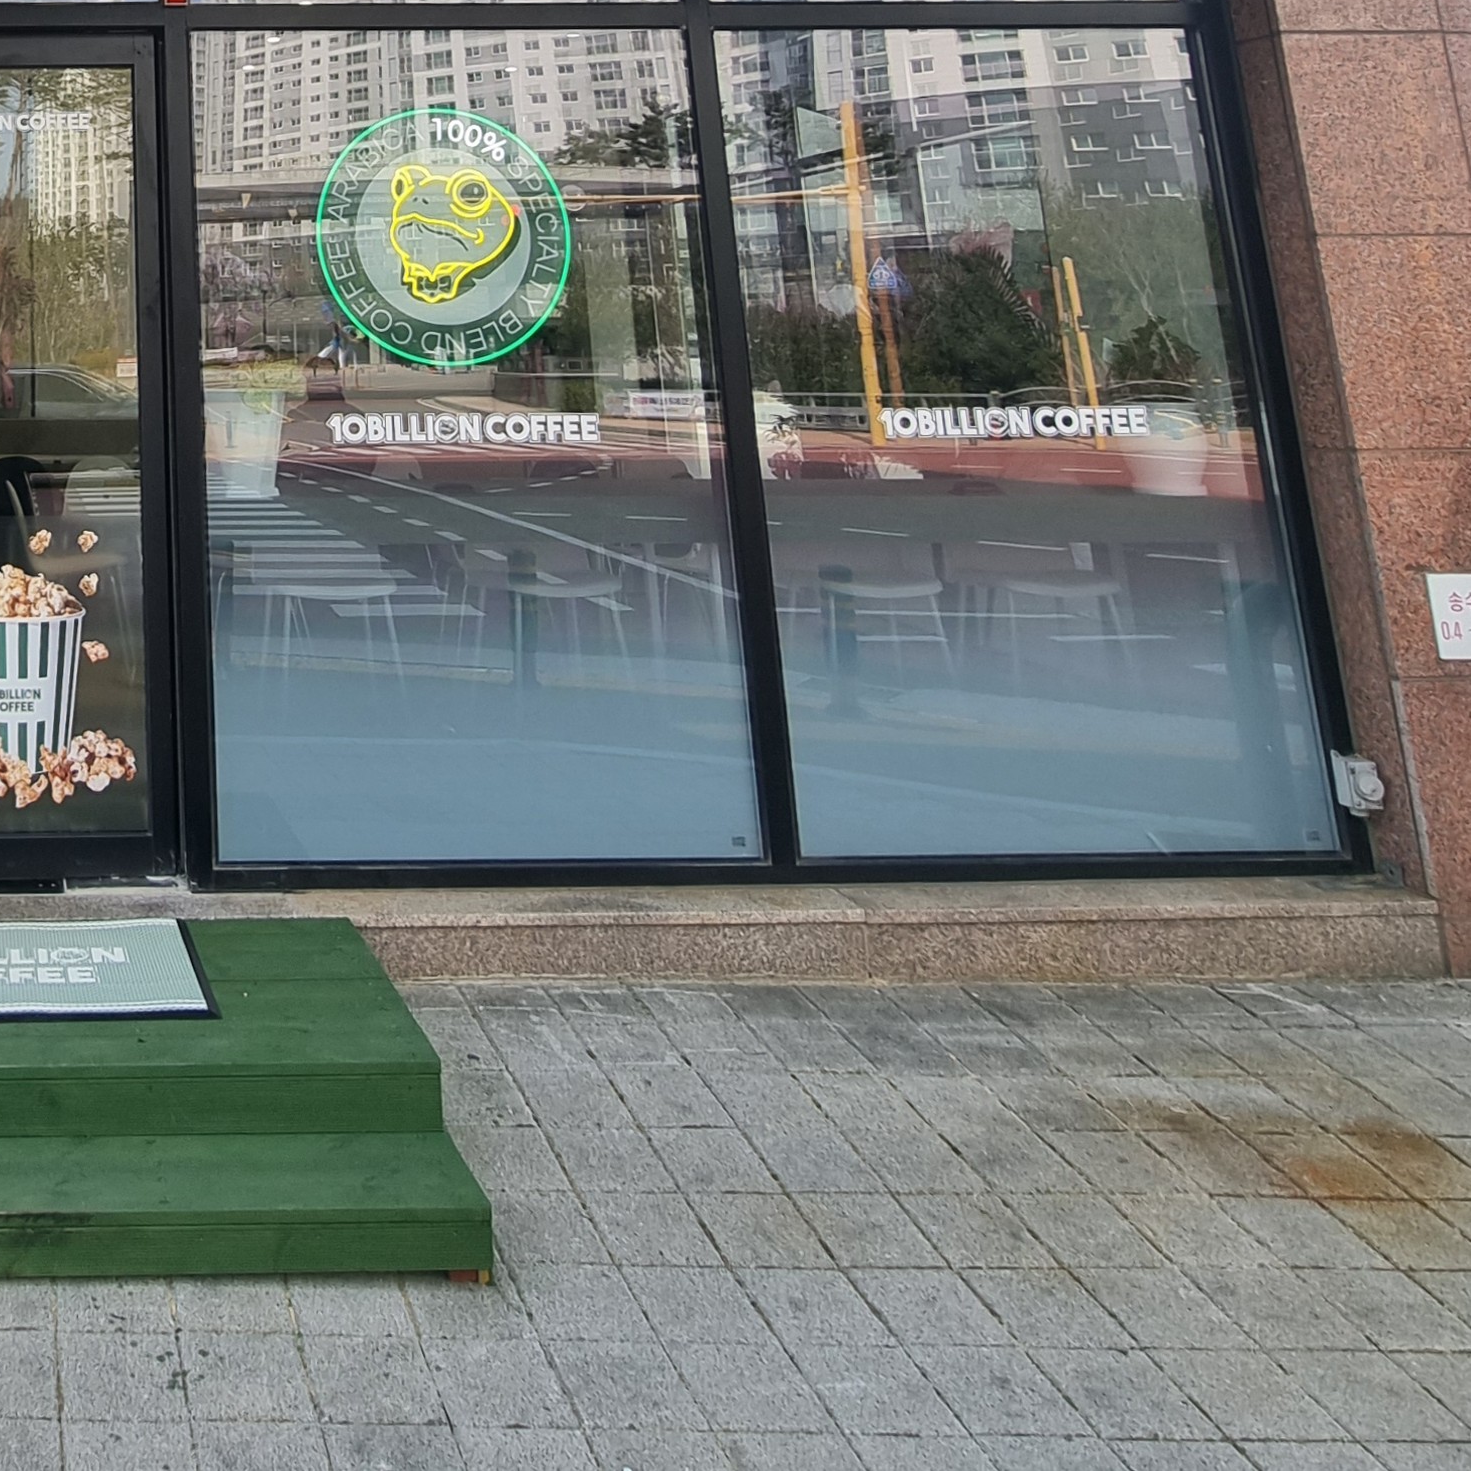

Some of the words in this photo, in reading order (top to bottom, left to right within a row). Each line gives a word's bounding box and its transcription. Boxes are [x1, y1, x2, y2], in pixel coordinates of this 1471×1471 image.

[16, 112, 92, 132] COFFEE
[431, 117, 506, 162] 100%
[327, 121, 425, 221] ARABICA
[506, 154, 561, 318] SPECIALTY
[330, 239, 414, 345] COFFEE
[421, 309, 524, 355] BLEND
[327, 413, 482, 444] 10BILLION
[484, 413, 600, 444] COFFEE
[879, 405, 1033, 439] 10BILLION
[1033, 405, 1149, 437] COFFEE
